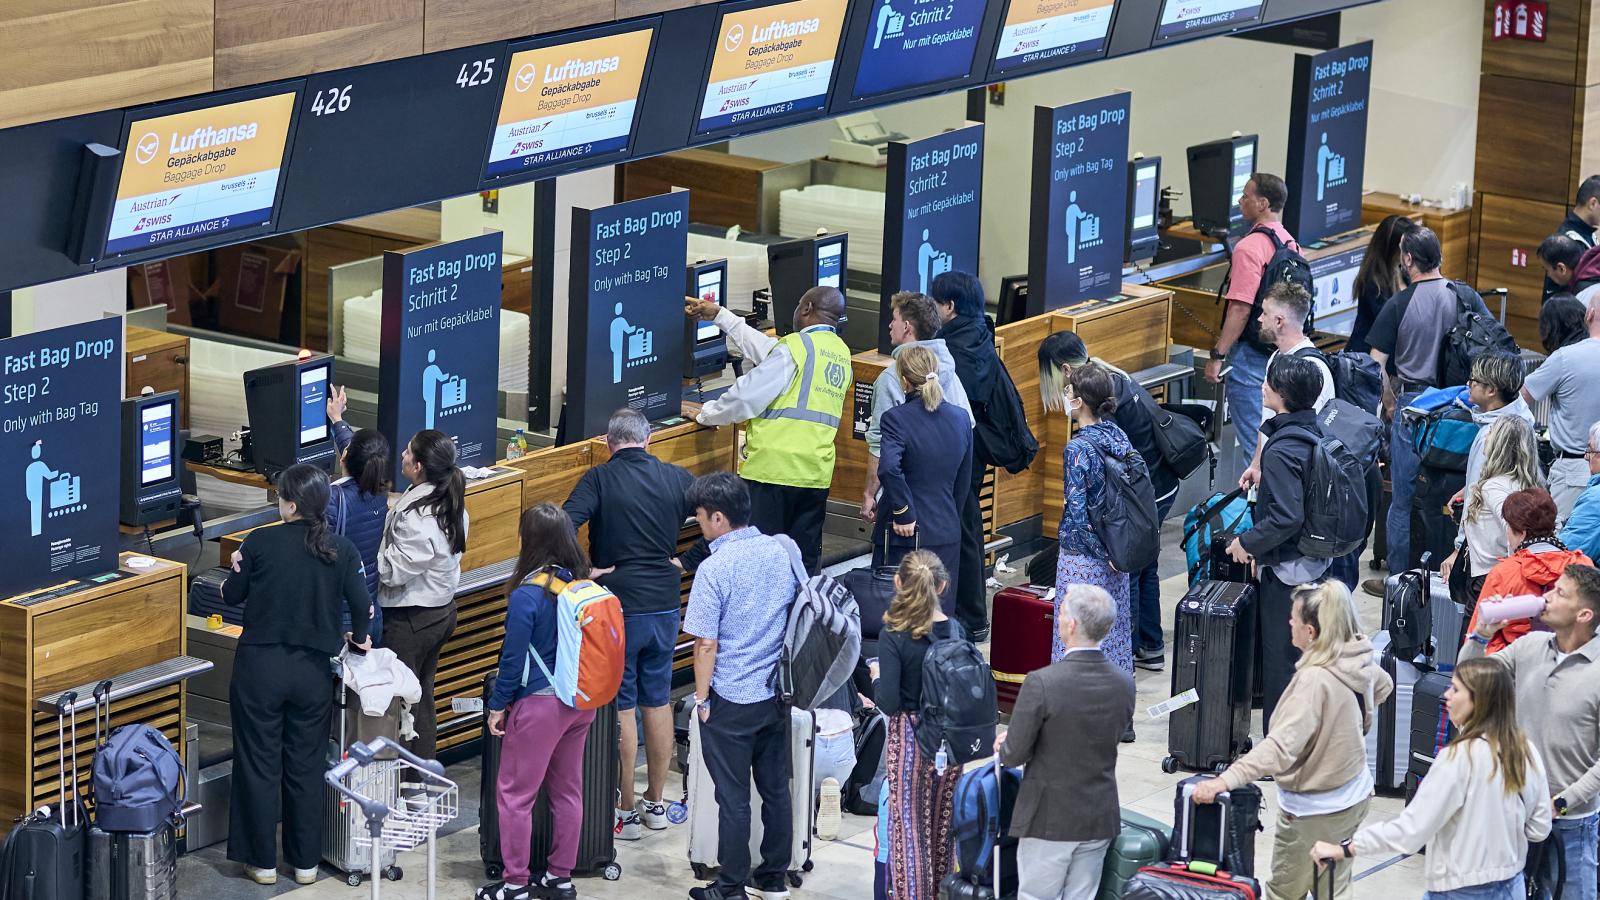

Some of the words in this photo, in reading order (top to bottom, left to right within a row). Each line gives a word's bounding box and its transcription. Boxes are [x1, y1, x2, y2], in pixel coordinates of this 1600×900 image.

[908, 7, 944, 27] Schritt
[945, 5, 953, 20] 2
[751, 18, 819, 44] Lufthansa
[902, 40, 916, 50] Nur
[918, 35, 932, 47] mit
[932, 26, 974, 45] Gepäcklabel
[748, 40, 802, 56] Gepäckabgabe
[1022, 52, 1040, 63] STAR
[1040, 46, 1070, 59] ALLIANCE
[456, 58, 495, 88] 425
[543, 56, 619, 83] Lufthansa
[1315, 64, 1330, 81] Fast
[1331, 61, 1346, 76] Bag
[1348, 56, 1369, 71] Drop
[541, 78, 600, 97] Gepäckabgabe
[718, 82, 747, 95] Austrian
[1312, 84, 1337, 102] Schritt
[1338, 80, 1344, 94] 2
[311, 84, 352, 116] 426
[538, 97, 571, 111] Baggage
[573, 93, 591, 105] Drop
[730, 98, 749, 108] SWISS
[731, 113, 750, 122] STAR
[751, 104, 785, 118] ALLIANCE
[1057, 118, 1076, 135] Fast
[1079, 114, 1098, 131] Bag
[1100, 108, 1125, 125] Drop
[170, 122, 258, 154] Lufthansa
[508, 124, 540, 138] Austrian
[520, 140, 543, 151] SWISS
[524, 154, 543, 166] STAR
[544, 147, 583, 161] ALLIANCE
[911, 153, 929, 172] Fast
[932, 150, 950, 166] Bag
[953, 142, 977, 159] Drop
[1056, 142, 1076, 158] Step
[1078, 137, 1084, 152] 2
[167, 147, 237, 168] Gepäckabgabe
[164, 168, 202, 183] Baggage
[205, 163, 226, 178] Drop
[1054, 168, 1069, 181] Only
[1070, 164, 1085, 177] with
[1086, 162, 1099, 173] Bag
[1100, 158, 1113, 170] Tag
[221, 180, 246, 191] brussels
[909, 174, 939, 196] Schritt
[941, 171, 947, 186] 2
[130, 196, 167, 213] Austrian
[908, 208, 919, 219] Nur
[920, 202, 931, 215] mit
[933, 190, 974, 212] Gepäcklabel
[146, 214, 172, 228] SWISS
[149, 229, 173, 242] STAR
[174, 220, 220, 236] ALLIANCE
[597, 220, 621, 240] Fast
[624, 217, 647, 235] Bag
[651, 210, 681, 228] Drop
[595, 248, 620, 266] Step
[624, 242, 631, 259] 2
[410, 264, 434, 286] Fast
[438, 260, 461, 279] Bag
[465, 252, 496, 271] Drop
[594, 277, 612, 291] Only
[614, 271, 632, 286] with
[635, 270, 650, 282] Bag
[653, 266, 668, 279] Tag
[409, 286, 447, 312] Schritt
[451, 284, 458, 300] 2
[407, 326, 422, 339] Nur
[424, 319, 438, 334] mit
[440, 305, 492, 330] Gepäcklabel
[5, 350, 36, 375] Fast
[40, 347, 70, 368] Bag
[75, 338, 114, 360] Drop
[4, 382, 36, 404] Step
[41, 377, 50, 395] 2
[4, 415, 27, 433] Only
[30, 409, 52, 427] with
[56, 406, 76, 421] Bag
[79, 401, 98, 417] Tag
